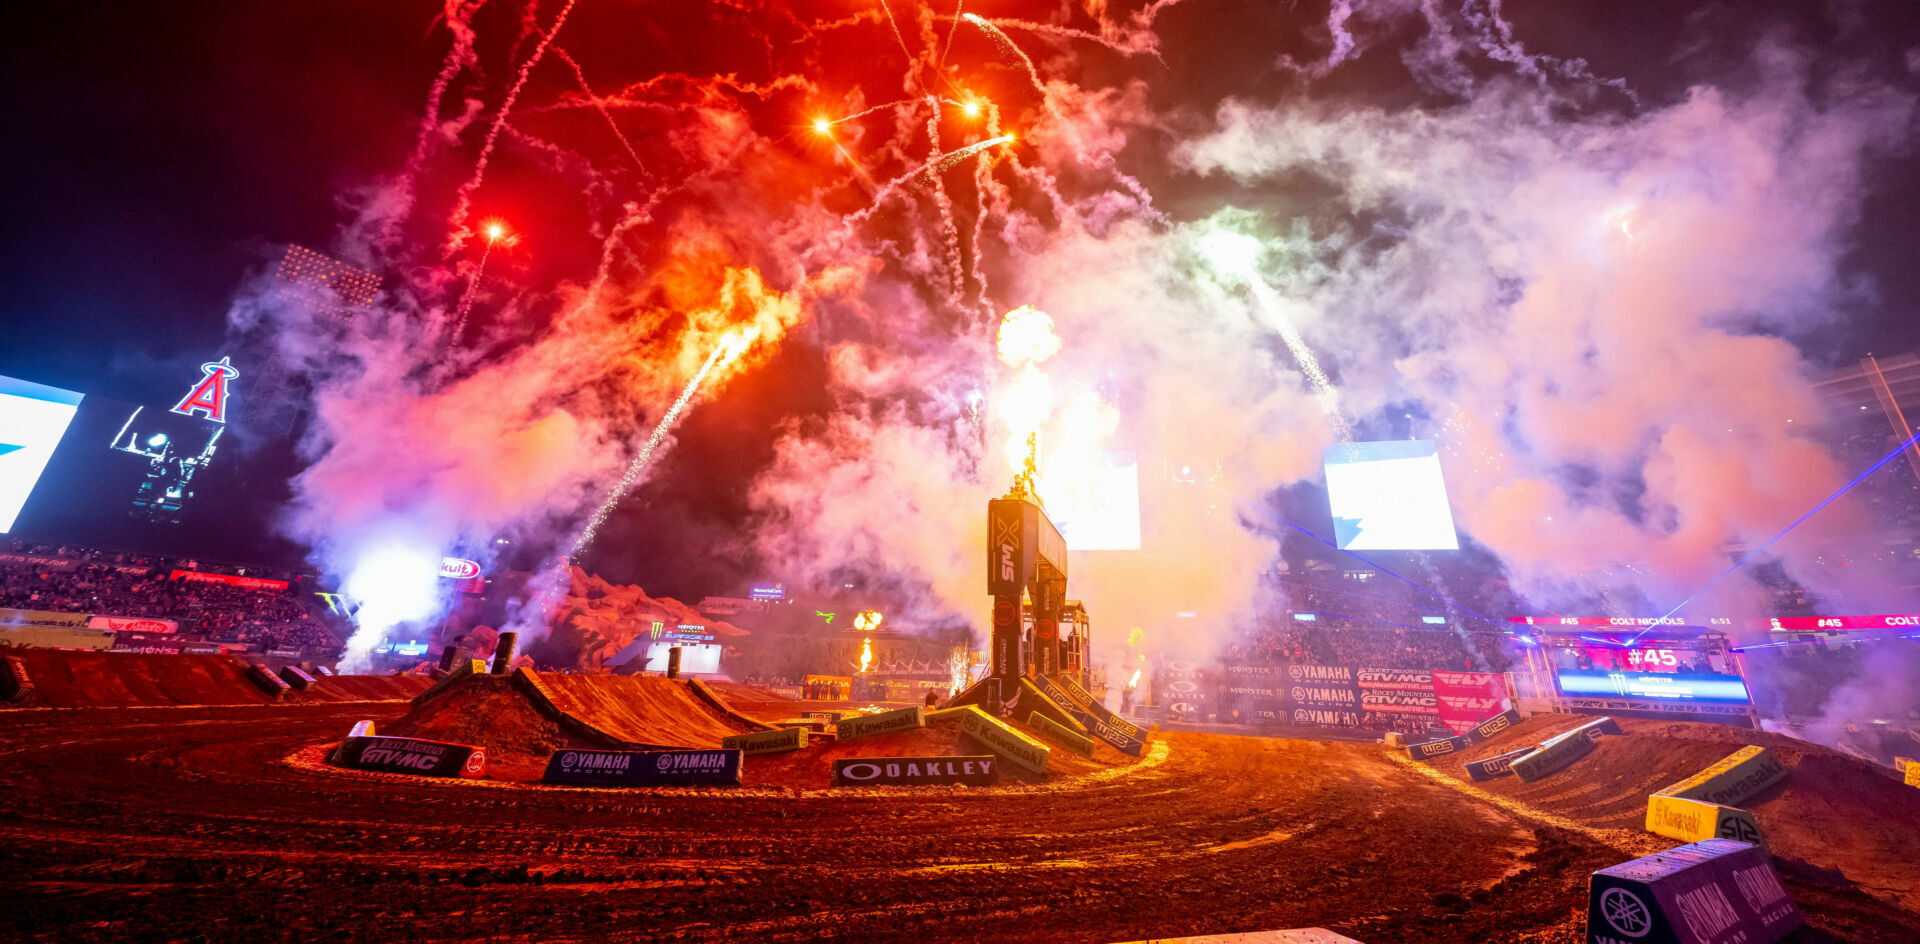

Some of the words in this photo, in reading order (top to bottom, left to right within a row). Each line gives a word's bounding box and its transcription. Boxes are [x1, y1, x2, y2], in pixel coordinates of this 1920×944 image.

[1560, 617, 1578, 625] #45
[1610, 617, 1635, 625] COLT
[1637, 617, 1684, 625] NICHOLS
[1711, 617, 1731, 625] 6:51
[1818, 619, 1843, 627] #45
[1885, 616, 1919, 626] COLT
[1628, 649, 1677, 666] #45
[1228, 665, 1271, 674] MONSTER
[1303, 665, 1351, 680] YAMAHA
[1444, 674, 1494, 686] FLY
[1068, 682, 1092, 707] WPS
[1230, 687, 1273, 697] MONSTER
[1305, 687, 1356, 703] YAMAHA
[1372, 689, 1395, 697] ROCKY
[1396, 689, 1436, 698] MOUNTAIN
[1446, 696, 1500, 709] FLY
[855, 711, 918, 736] Kawasaki
[1110, 715, 1137, 737] WPS
[1479, 715, 1510, 738] WPS
[739, 731, 798, 751] Kawasaki
[1096, 722, 1129, 748] WPS
[981, 726, 1045, 767] Kawasaki
[1422, 741, 1454, 756] WPS
[577, 753, 631, 769] YAMAHA
[673, 753, 726, 769] YAMAHA
[886, 760, 993, 778] OAKLEY
[1663, 805, 1701, 834] Kawasaki
